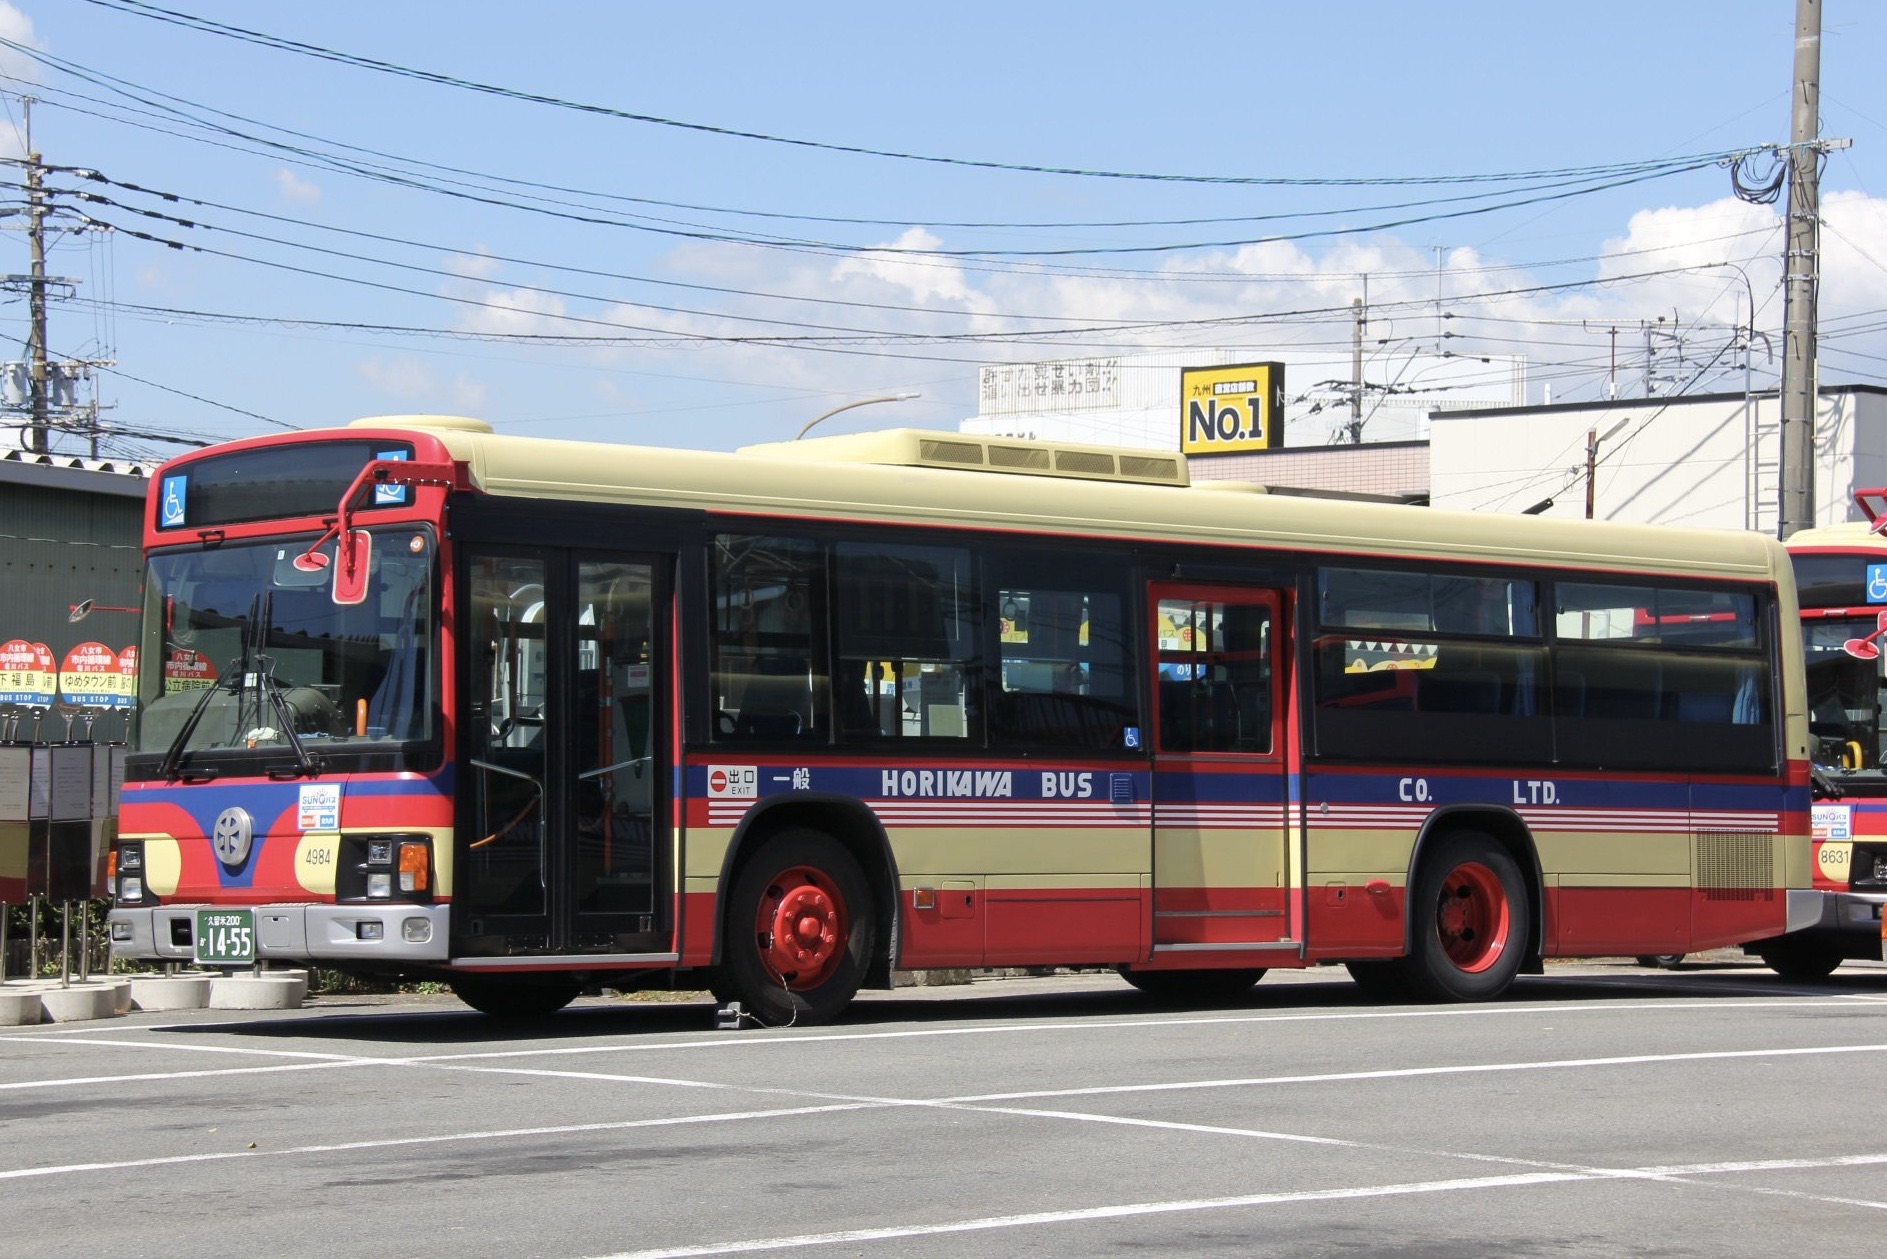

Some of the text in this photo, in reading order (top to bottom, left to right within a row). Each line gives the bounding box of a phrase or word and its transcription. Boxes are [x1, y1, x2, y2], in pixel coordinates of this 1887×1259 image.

[1189, 398, 1262, 442] No.1
[81, 646, 102, 655] 八女市
[0, 673, 34, 686] 下福島
[65, 674, 117, 689] ゆめタウン前
[90, 695, 109, 703] STOP
[729, 769, 754, 784] 出口
[772, 767, 810, 790] 一般
[732, 787, 751, 795] EXIT
[882, 769, 1560, 805] HORIKAWA BUS CO. LTD.
[306, 848, 331, 865] 4984
[1821, 850, 1849, 864] 8631
